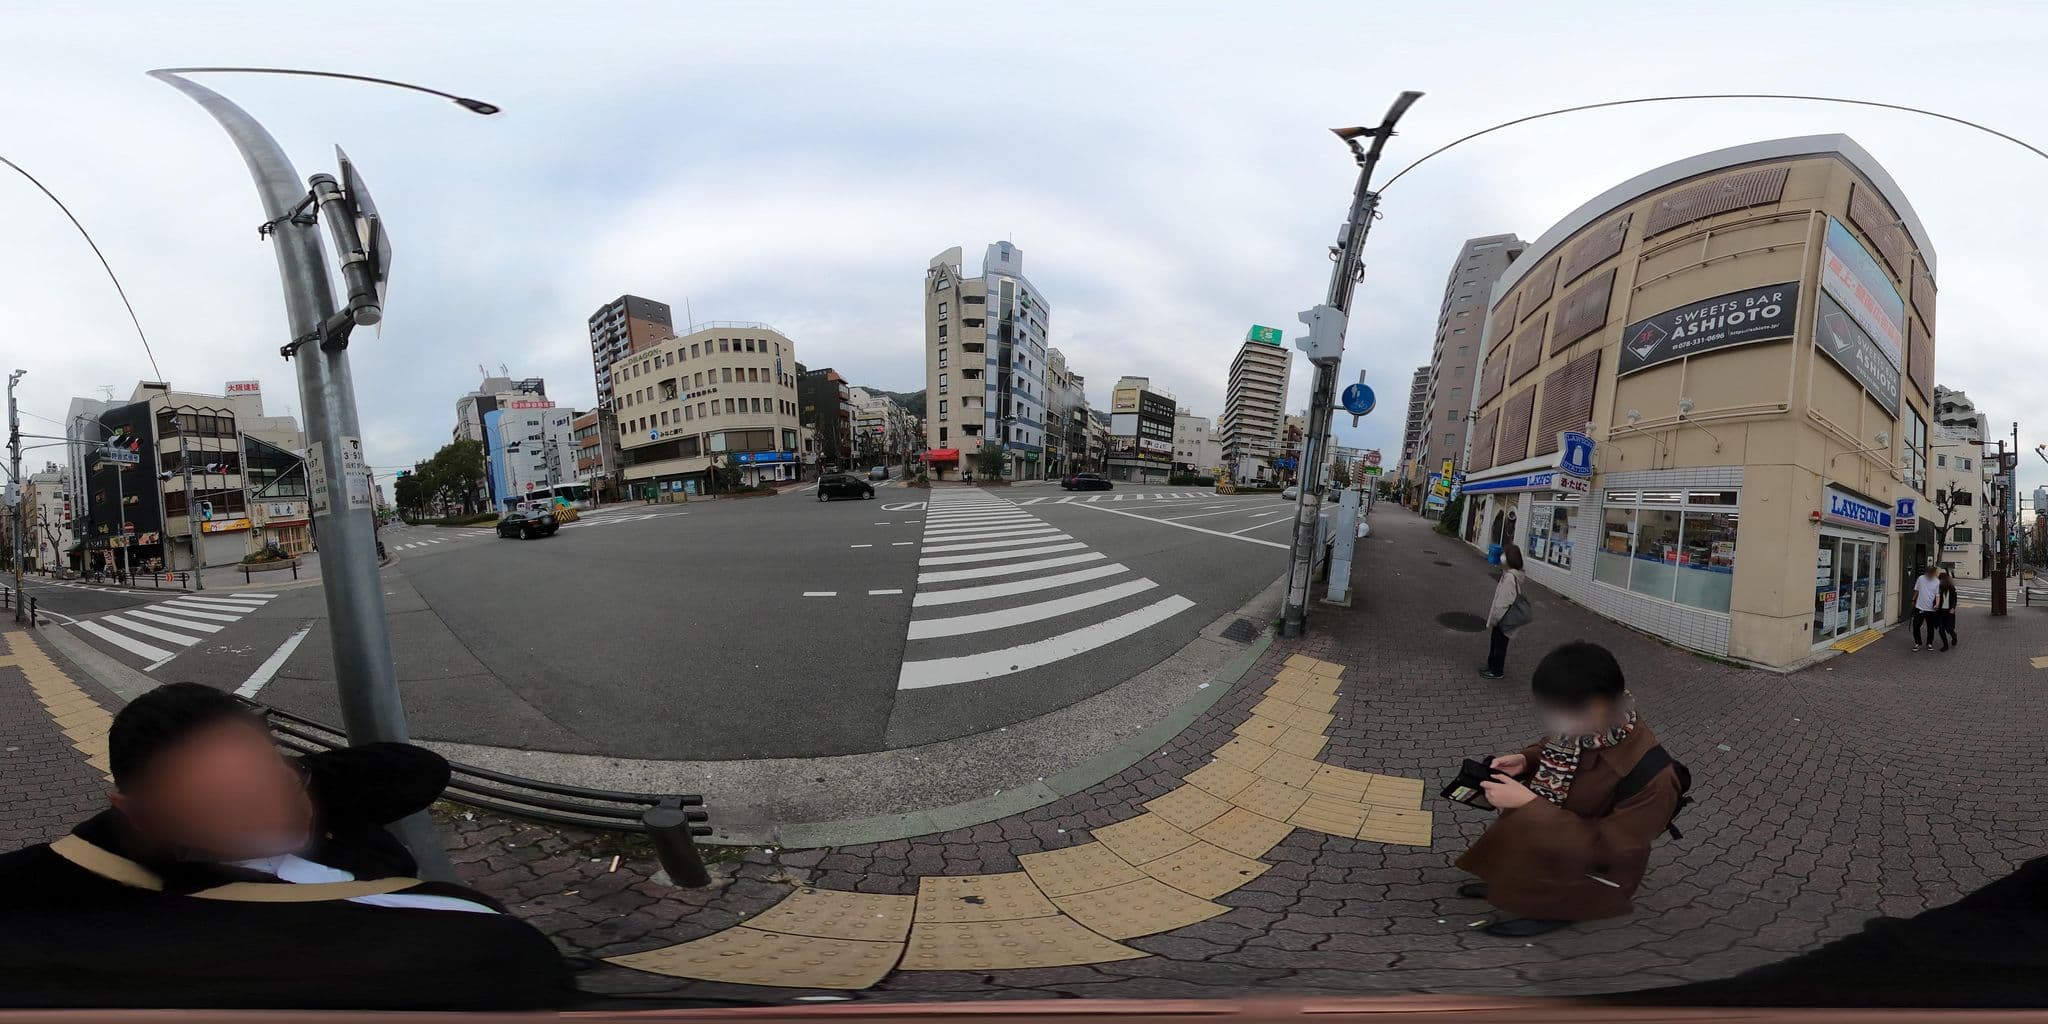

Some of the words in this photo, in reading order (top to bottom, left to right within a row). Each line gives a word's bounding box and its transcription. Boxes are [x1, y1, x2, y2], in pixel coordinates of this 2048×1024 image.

[1671, 304, 1781, 340] ASHIOTO
[1674, 300, 1737, 325] SWEETS
[1745, 292, 1783, 307] BAR
[1856, 349, 1897, 397] ASHIOTO
[1567, 434, 1593, 448] LAWSON
[1564, 461, 1589, 473] STATION
[1831, 496, 1879, 524] LAWSON
